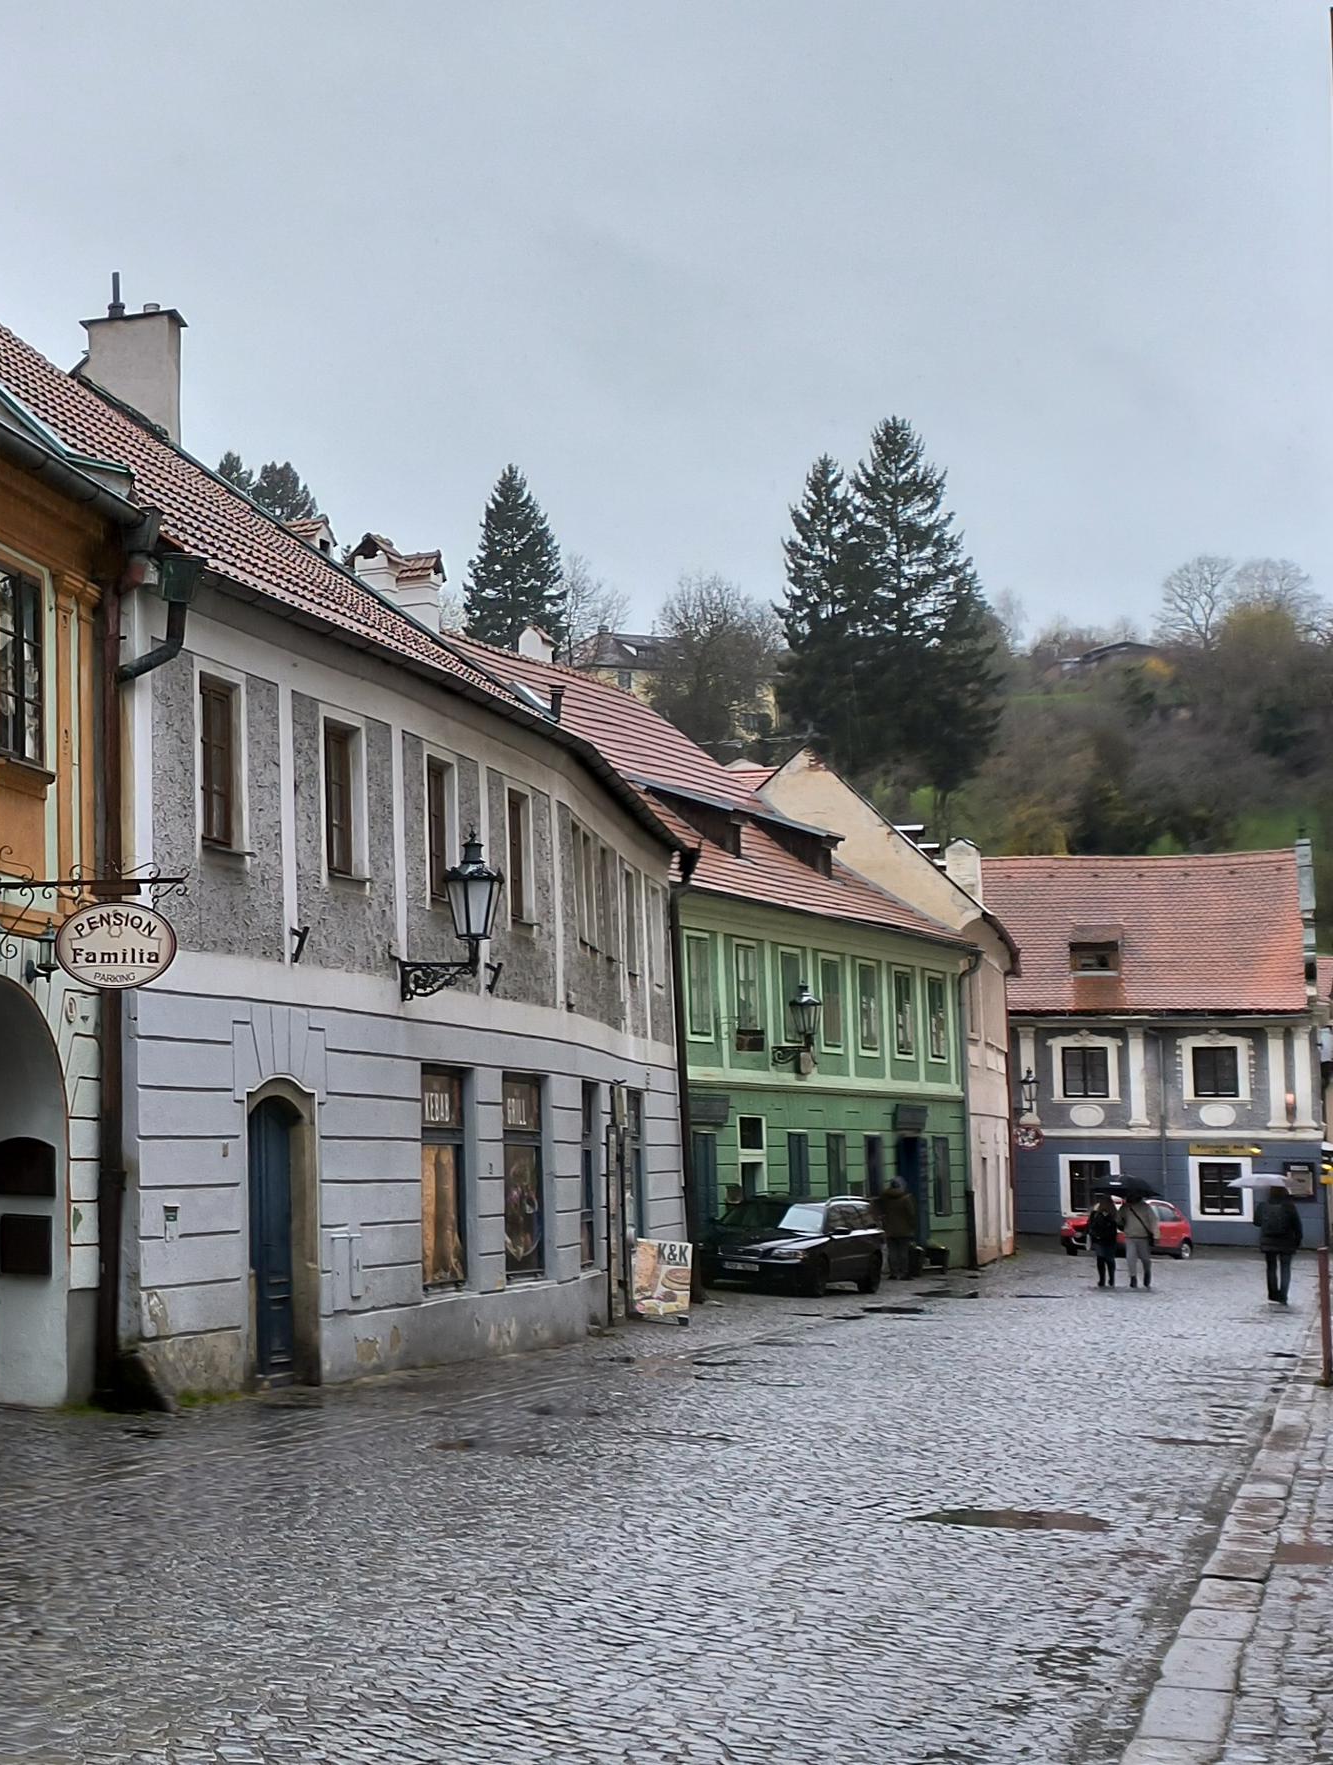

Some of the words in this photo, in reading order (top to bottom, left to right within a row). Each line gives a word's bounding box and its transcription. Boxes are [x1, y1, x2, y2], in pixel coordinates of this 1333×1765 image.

[73, 912, 157, 938] PENSION
[71, 947, 160, 964] Familia
[93, 971, 136, 984] PARKING
[424, 1092, 450, 1122] KEBAB
[507, 1097, 527, 1125] GRILL
[658, 1243, 689, 1263] K&K
